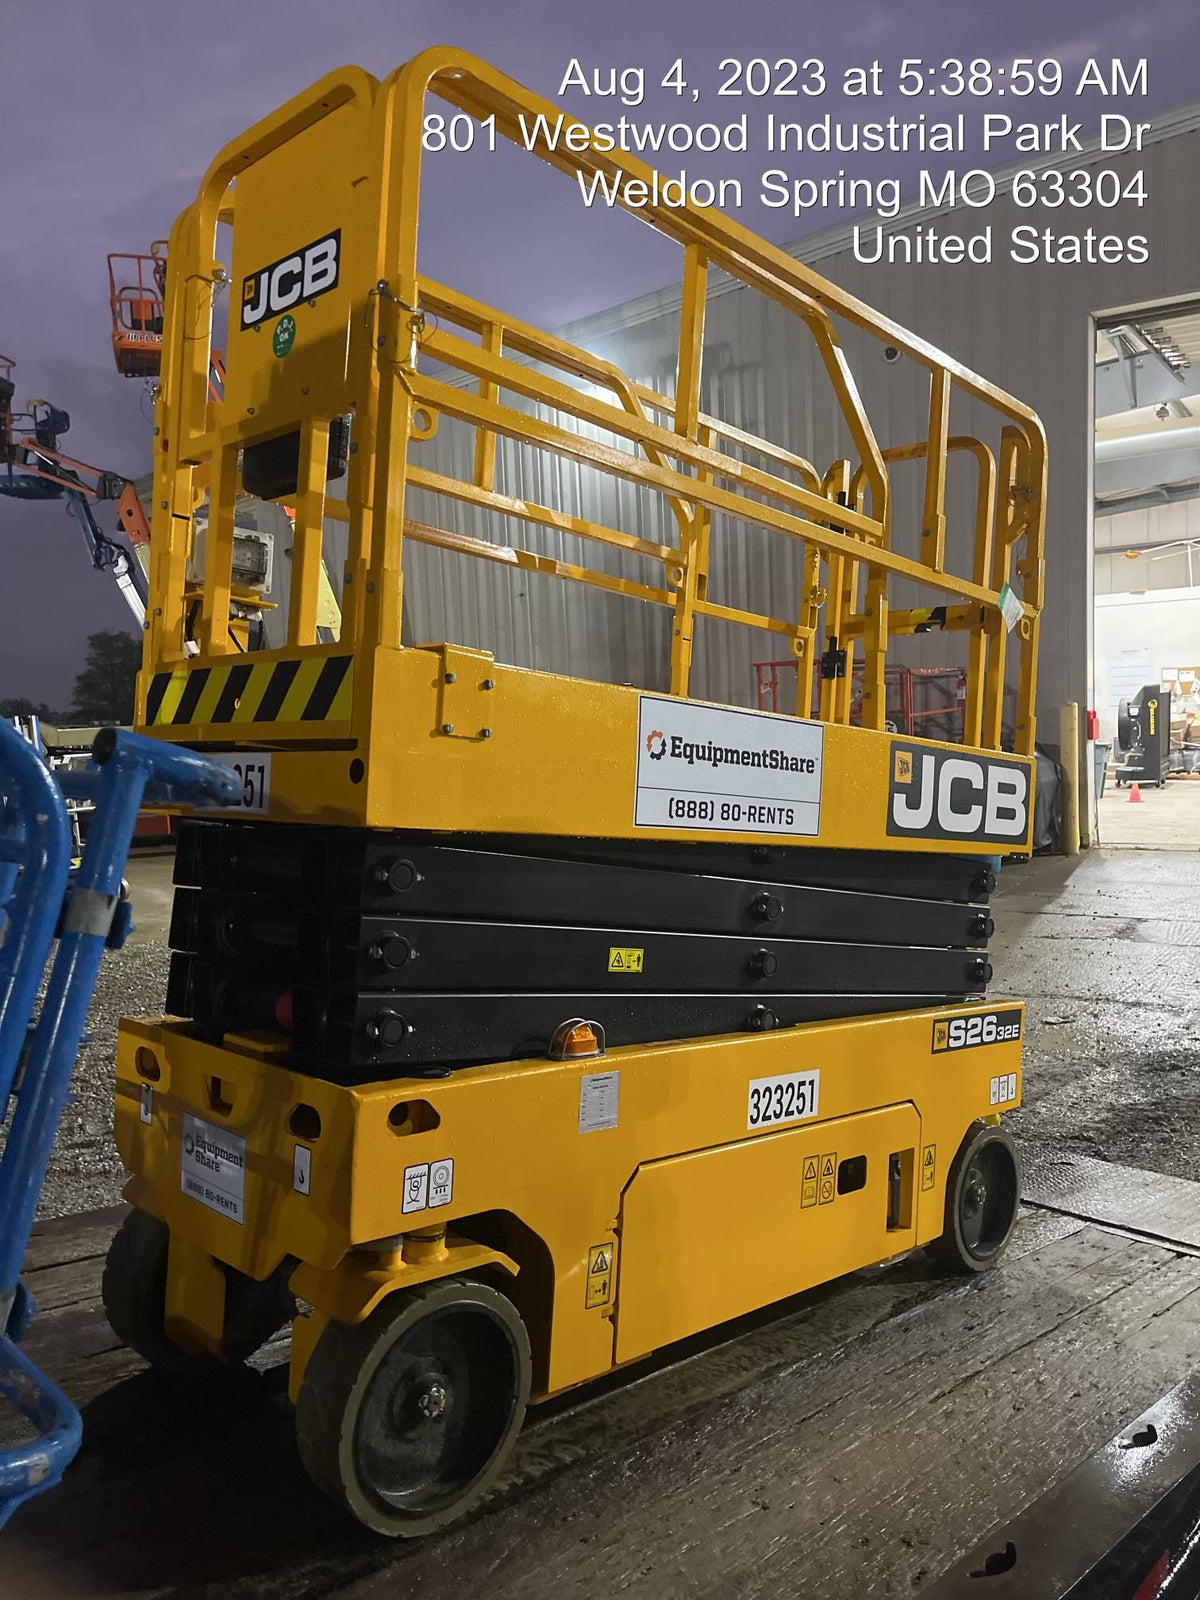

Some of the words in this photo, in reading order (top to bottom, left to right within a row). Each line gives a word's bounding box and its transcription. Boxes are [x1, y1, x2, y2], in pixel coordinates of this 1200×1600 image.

[243, 237, 338, 325] JCB
[669, 735, 816, 774] EquipmentShare
[668, 797, 715, 822] (888)
[720, 802, 795, 826] 80-RENTS
[892, 754, 1027, 836] JCB
[948, 1014, 998, 1048] S26
[996, 1023, 1020, 1040] 32E
[749, 1078, 815, 1125] 323251
[194, 1150, 221, 1173] Share
[195, 1134, 244, 1168] Equipment
